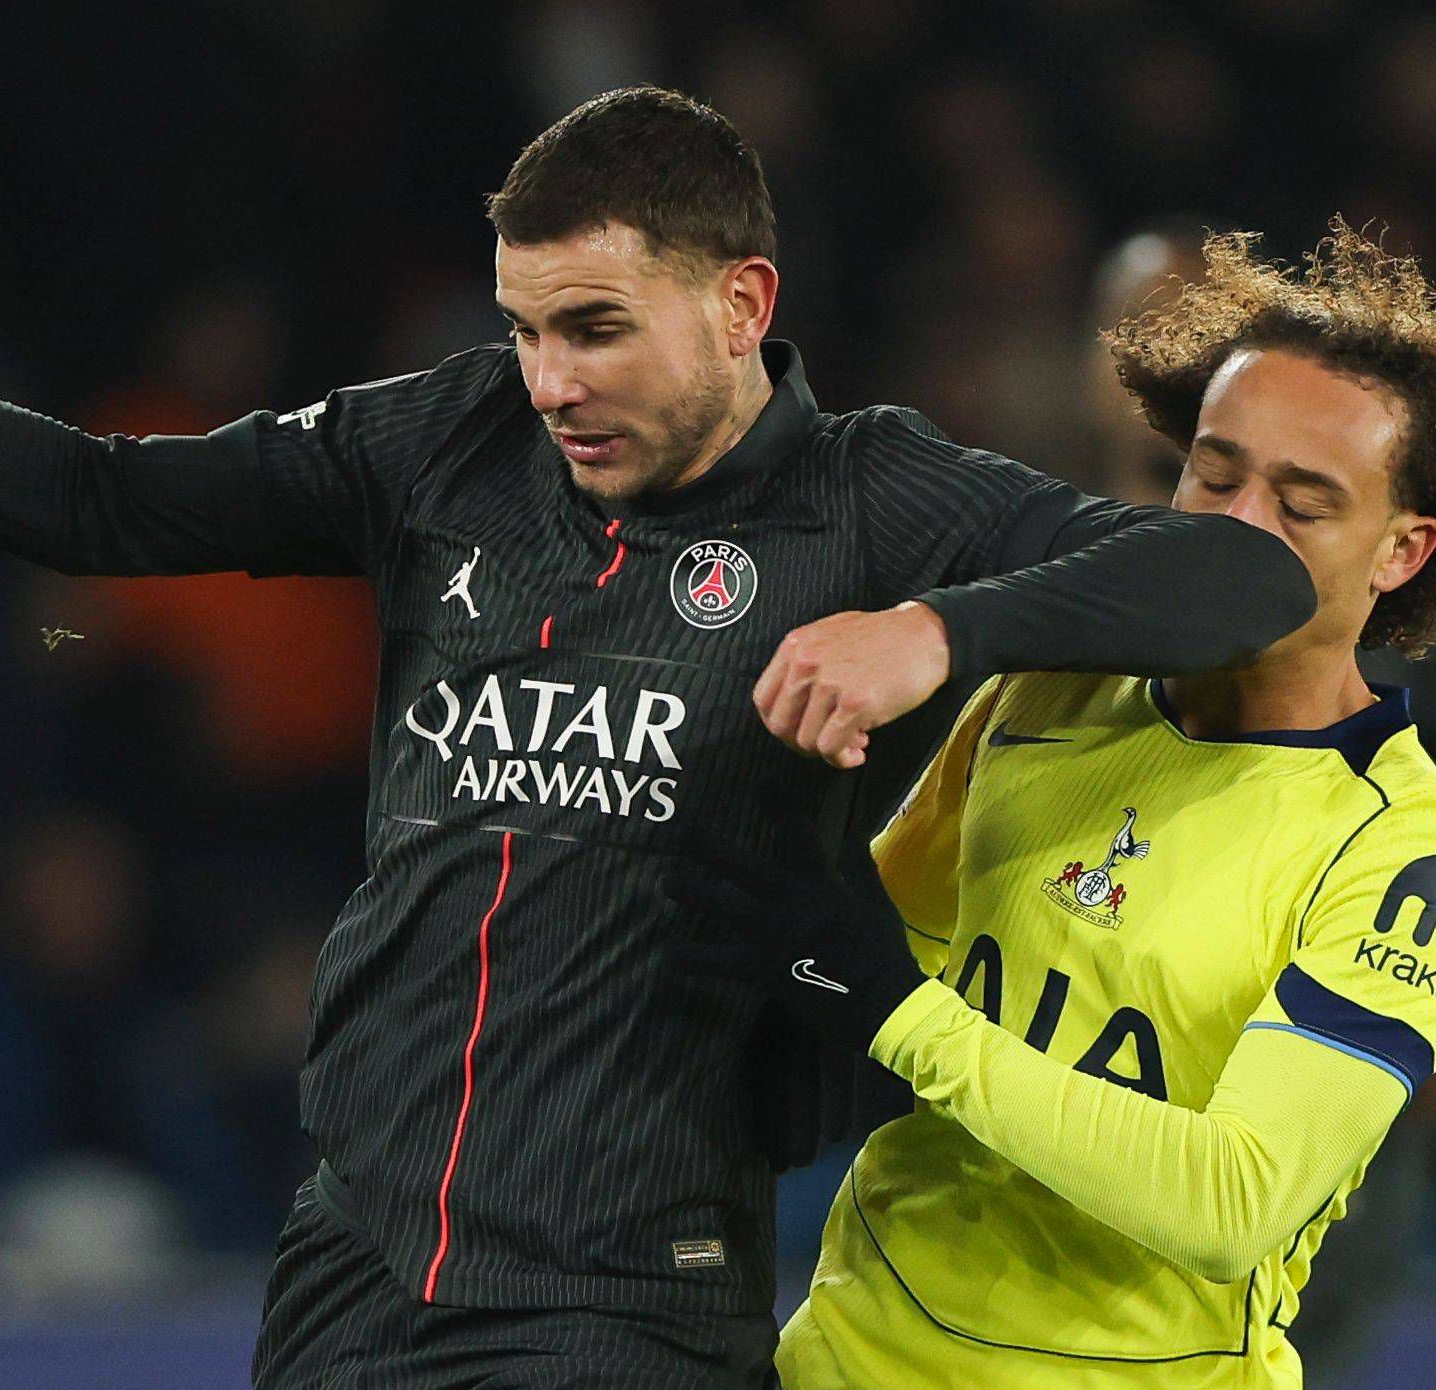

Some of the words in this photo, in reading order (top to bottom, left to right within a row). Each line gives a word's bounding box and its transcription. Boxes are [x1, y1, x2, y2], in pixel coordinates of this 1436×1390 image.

[690, 544, 748, 572] PARIS
[405, 674, 686, 770] QATAR
[453, 755, 678, 822] AIRWAYS
